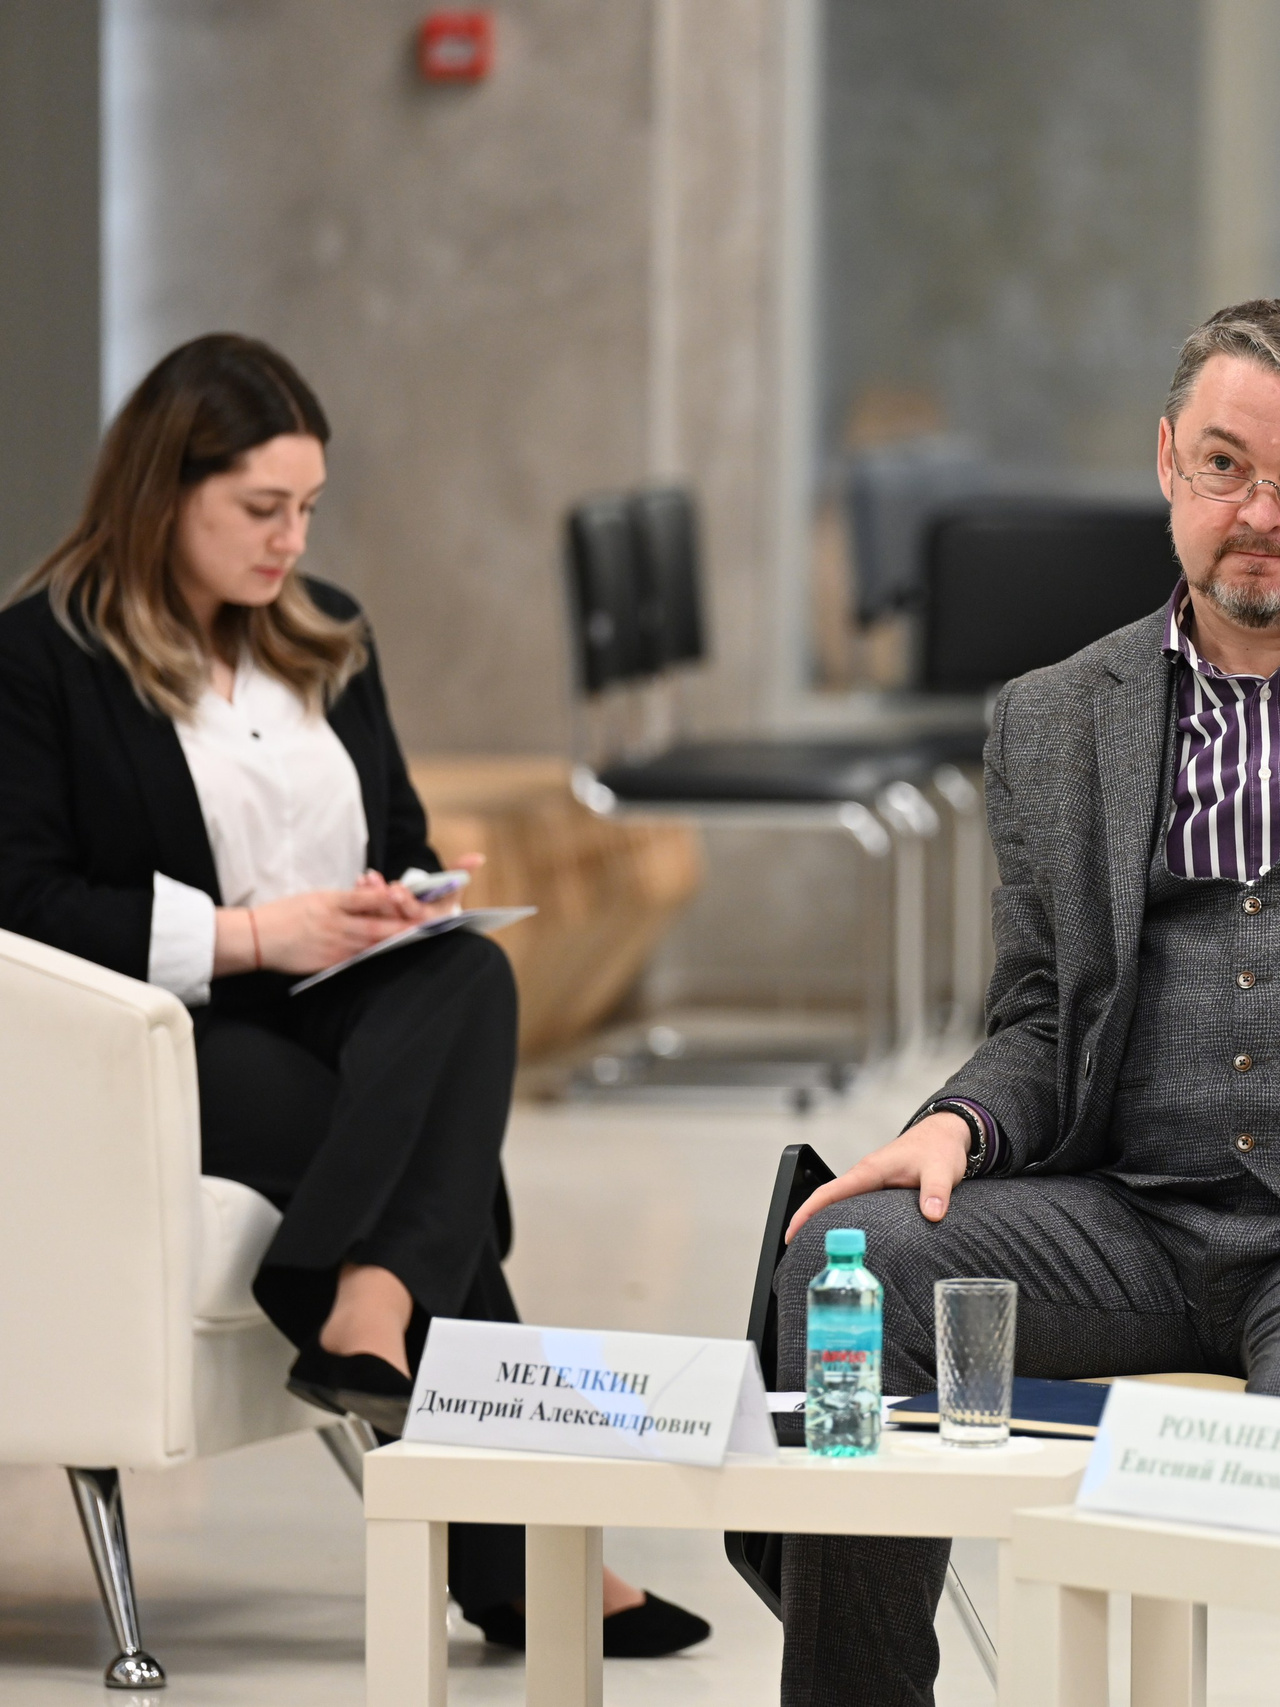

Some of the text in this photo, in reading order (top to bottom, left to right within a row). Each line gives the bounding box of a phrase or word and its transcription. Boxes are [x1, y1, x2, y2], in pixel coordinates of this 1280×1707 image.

[496, 1361, 650, 1396] МЕТЕЛКИН
[416, 1390, 712, 1438] Дмитрий Александрович
[1118, 1447, 1216, 1481] Евгений
